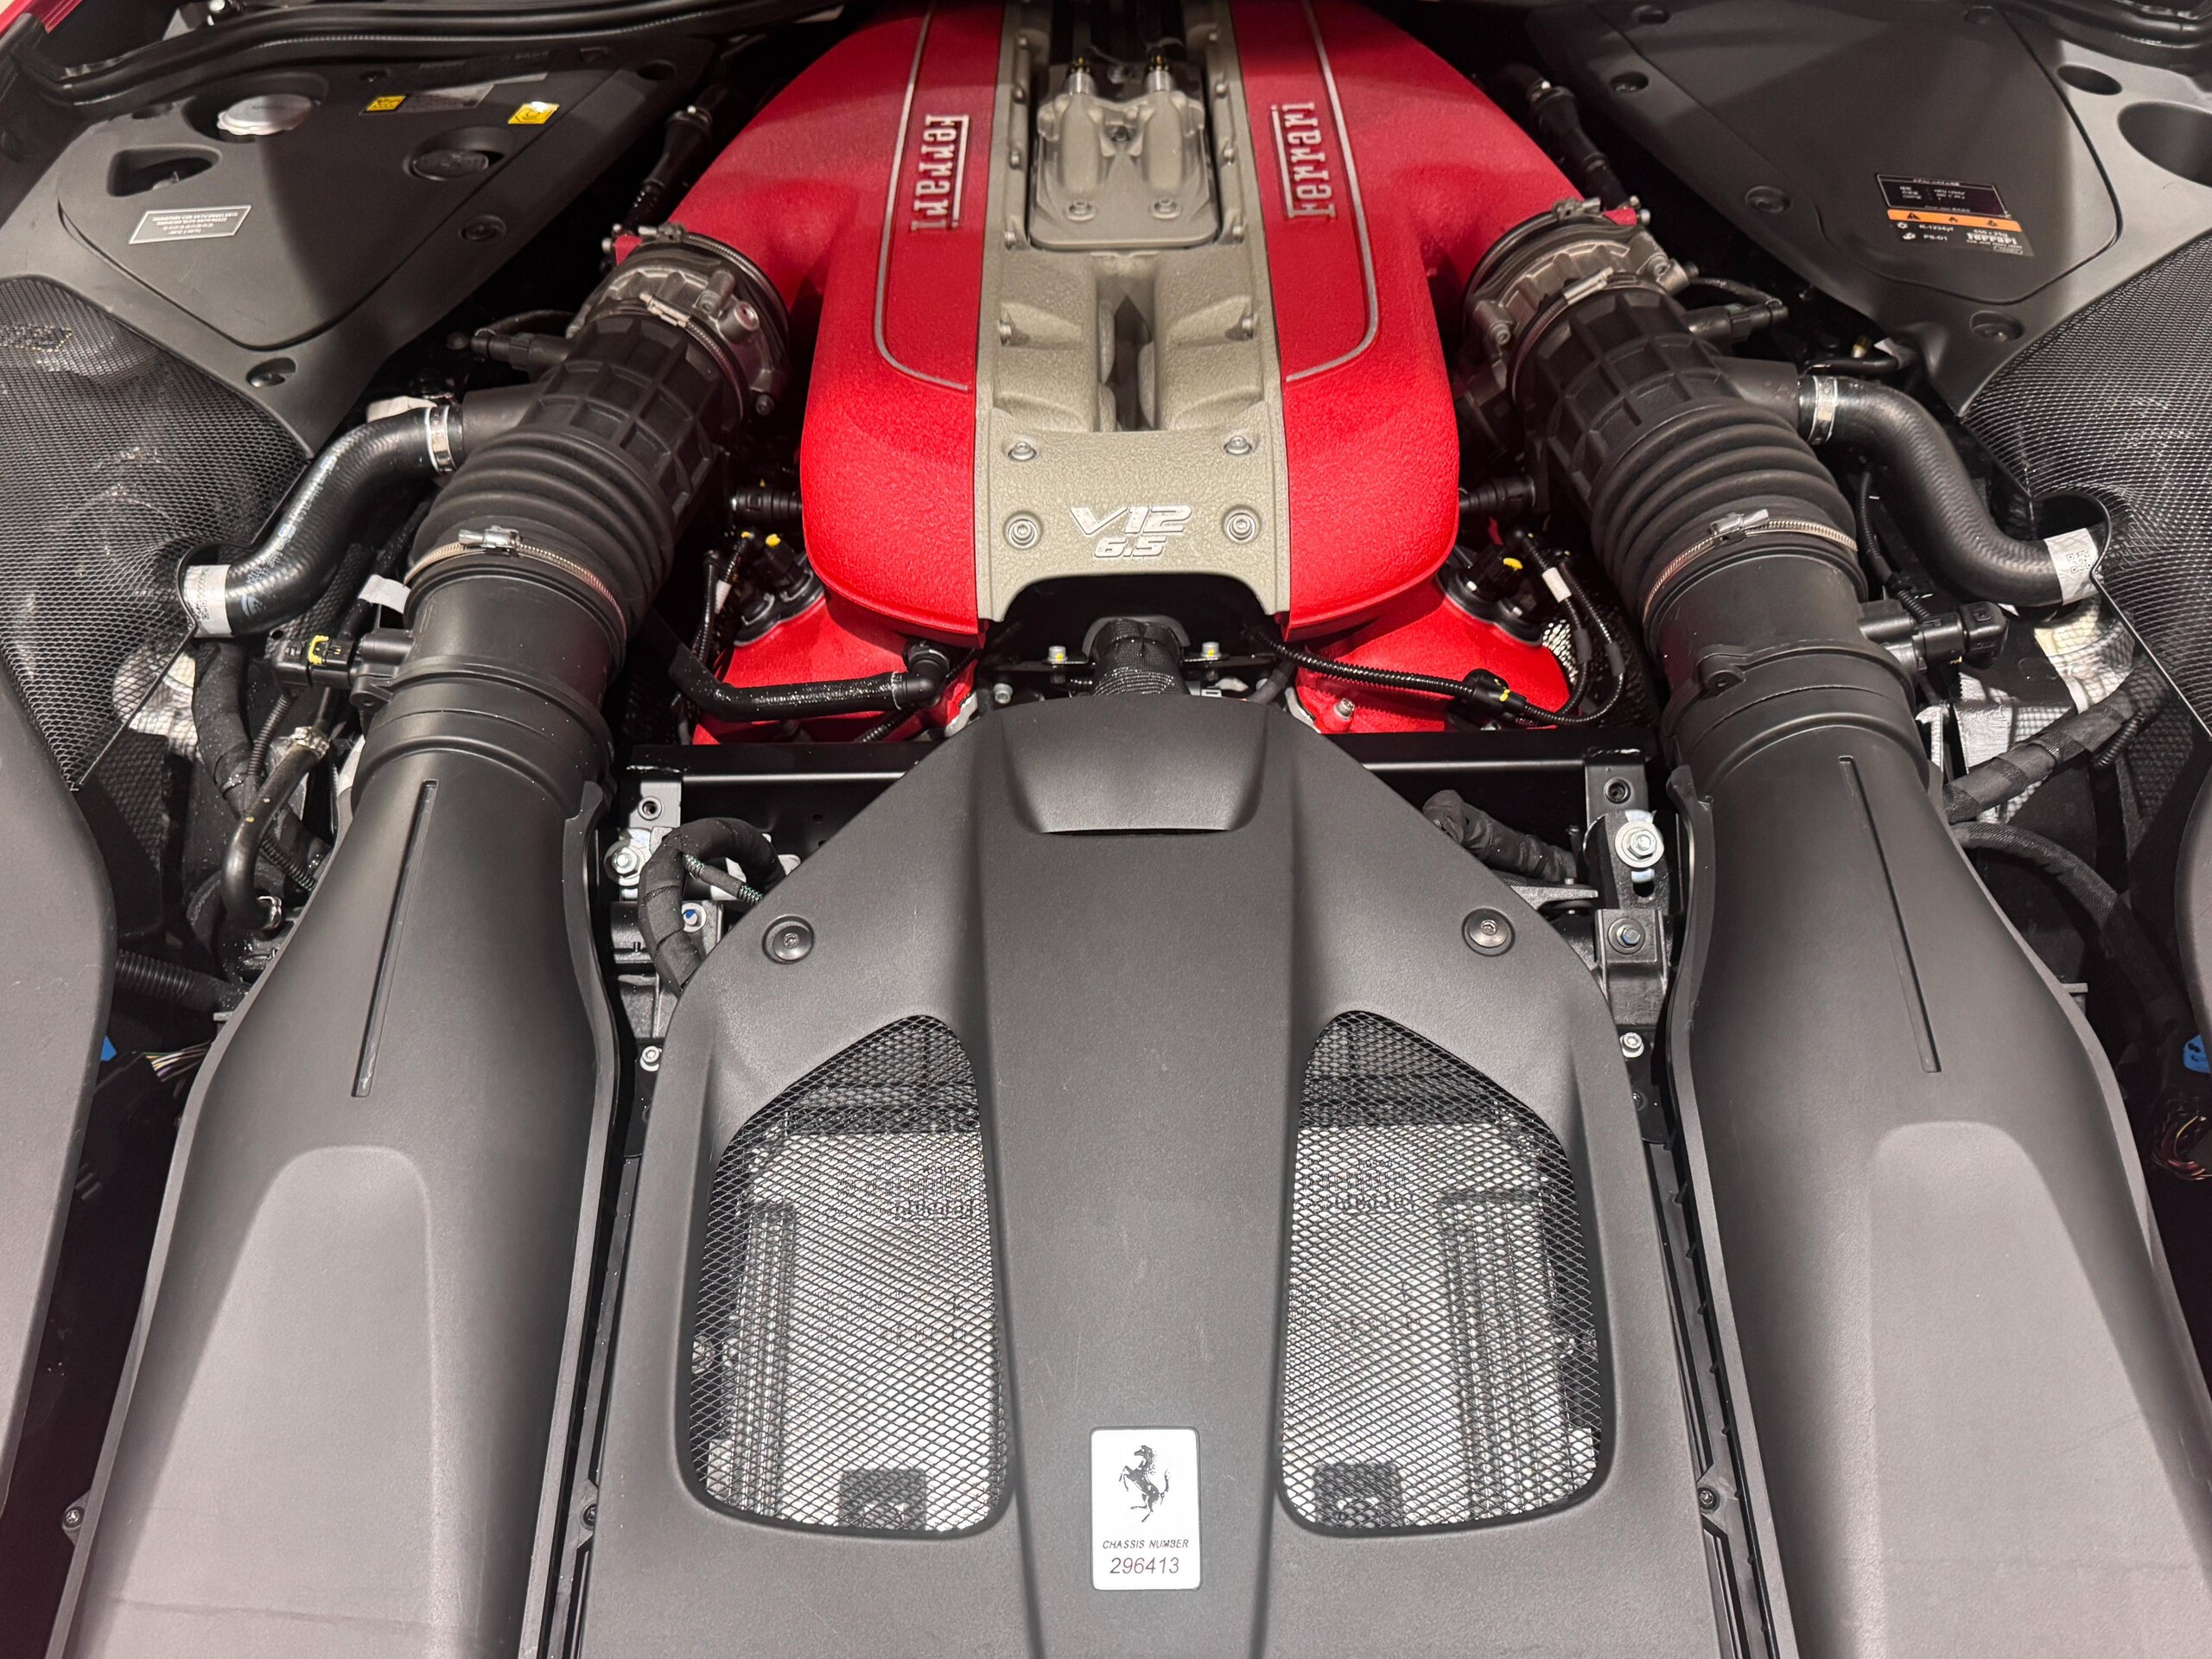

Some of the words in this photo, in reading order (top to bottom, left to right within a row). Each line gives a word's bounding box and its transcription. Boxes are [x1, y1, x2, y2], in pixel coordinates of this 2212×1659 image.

[1271, 101, 1336, 218] Ferrari
[911, 114, 969, 231] Ferrari
[1967, 232, 2018, 245] Ferrari
[1070, 505, 1192, 535] V12
[1094, 536, 1166, 558] 6.5
[1103, 1540, 1146, 1549] CHASSIS
[1149, 1539, 1190, 1548] NUMBER
[1109, 1557, 1180, 1574] 296413
